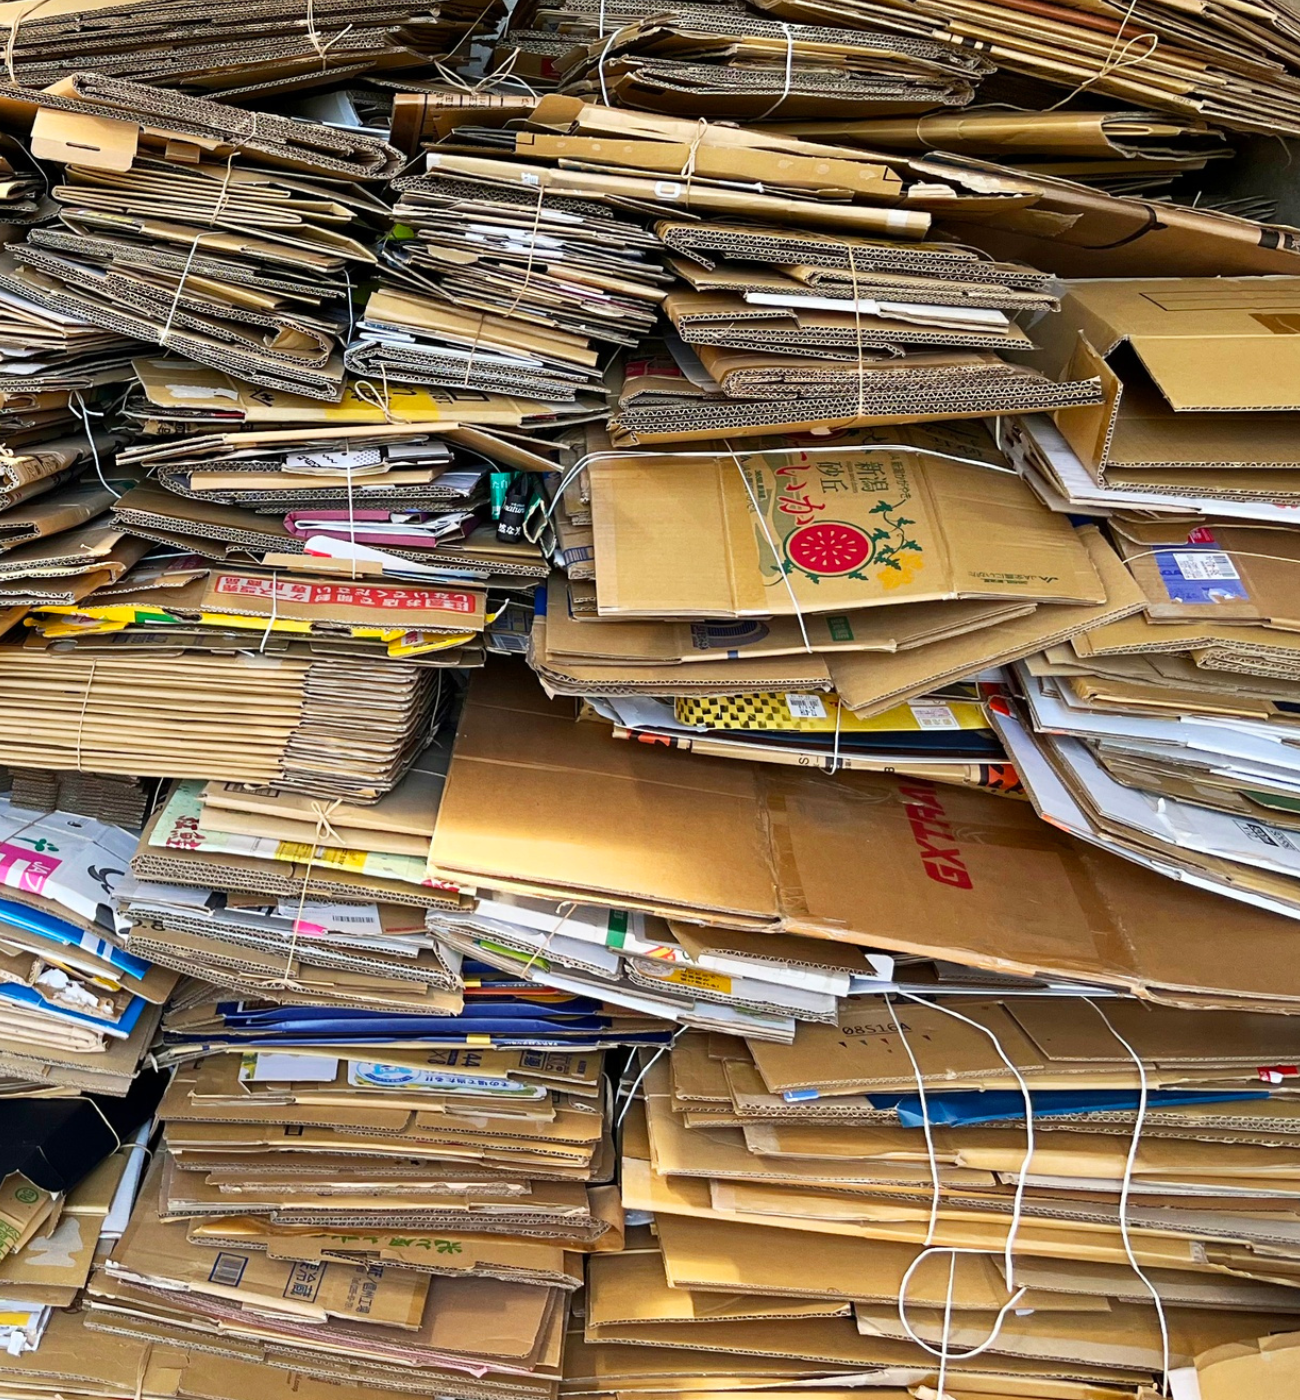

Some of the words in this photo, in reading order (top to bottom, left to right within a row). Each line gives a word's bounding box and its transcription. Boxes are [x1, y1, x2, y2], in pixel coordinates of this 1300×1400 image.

[816, 461, 849, 494] 砂丘
[854, 461, 889, 493] 新潟
[776, 452, 826, 526] いか
[314, 594, 422, 607] お店で開封
[316, 587, 468, 602] しないでください
[425, 1075, 510, 1089] その場で当たる!!
